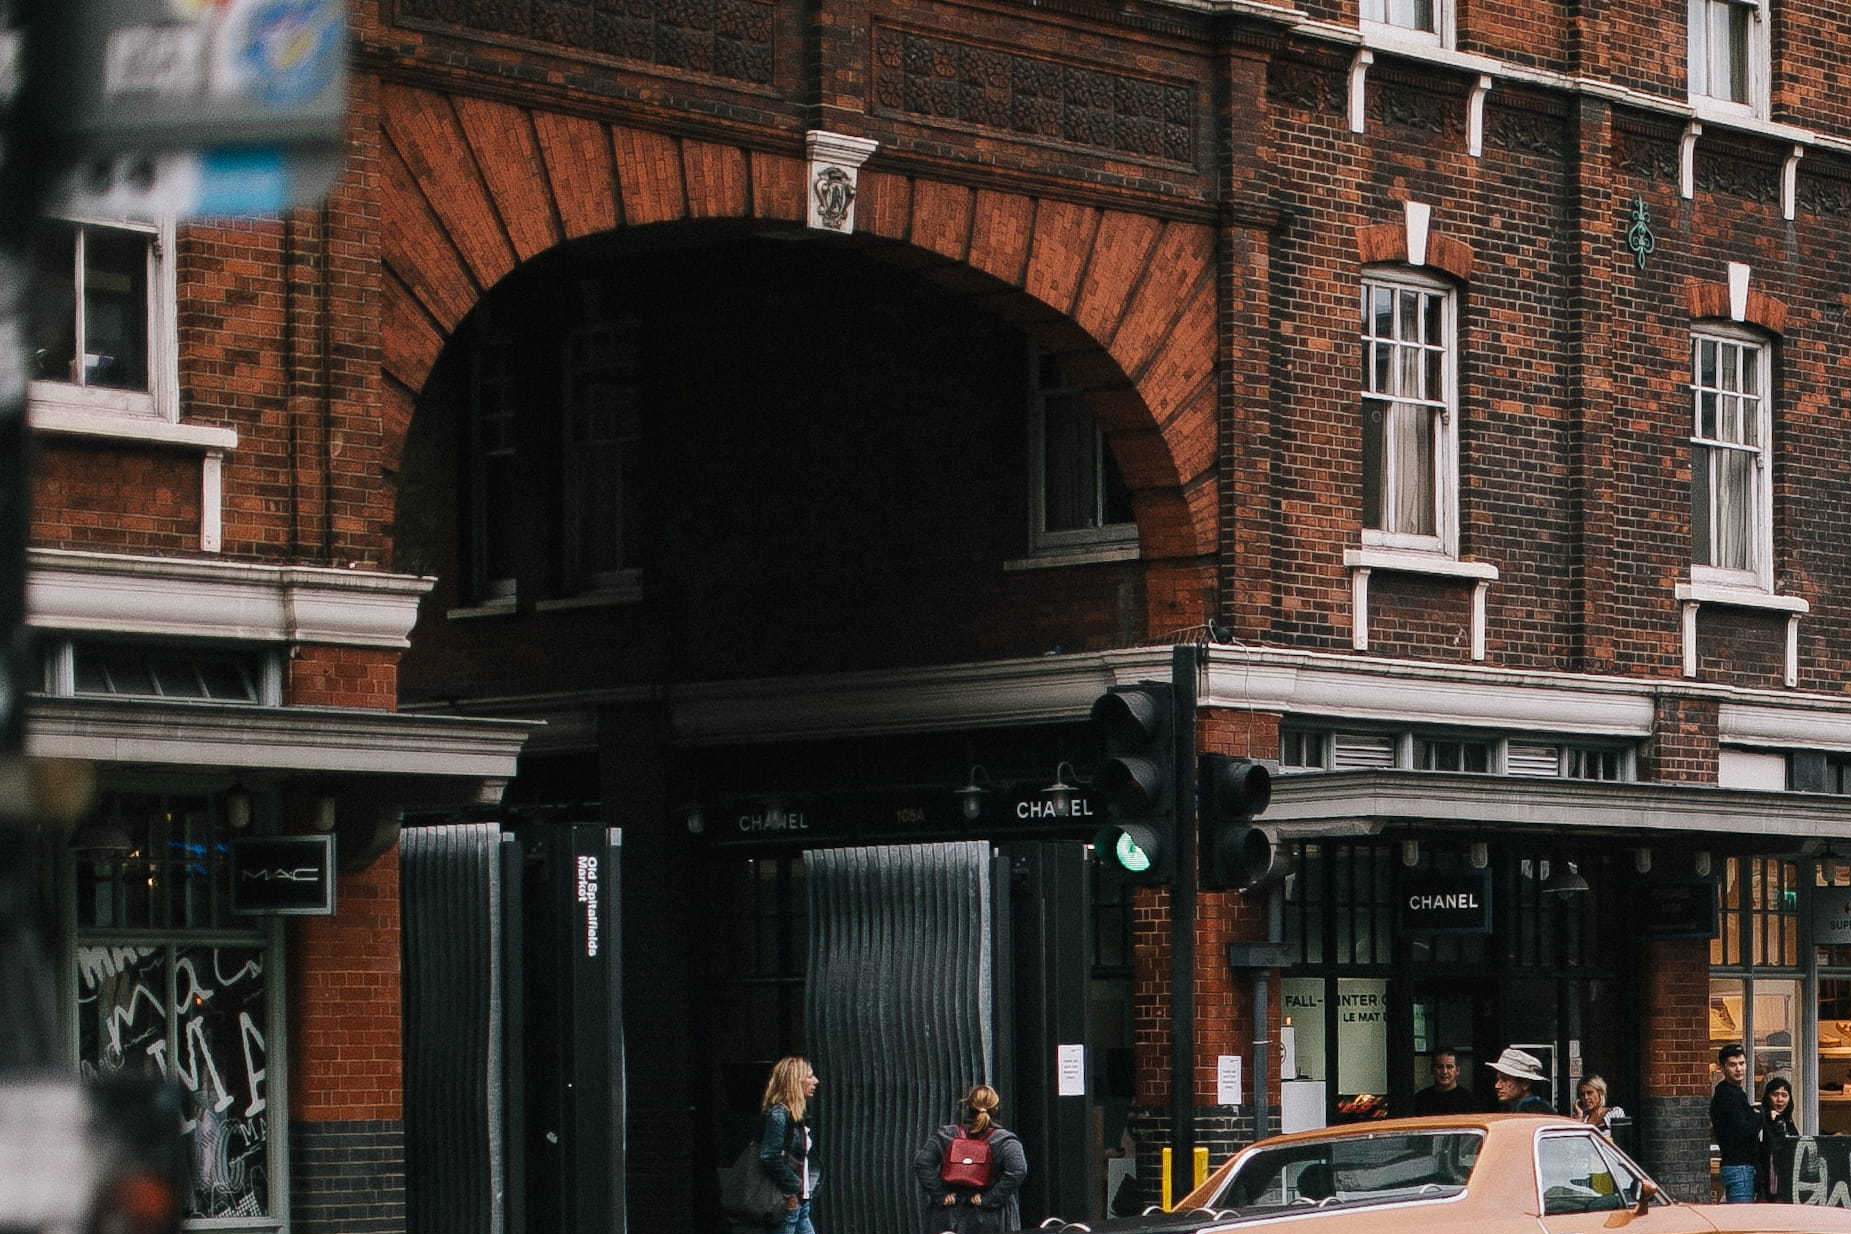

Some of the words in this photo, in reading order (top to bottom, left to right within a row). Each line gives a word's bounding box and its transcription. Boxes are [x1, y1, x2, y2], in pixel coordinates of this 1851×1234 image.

[1016, 799, 1093, 819] CHAEL
[577, 855, 589, 903] Market
[587, 856, 598, 880] Old
[1409, 893, 1479, 910] CHANEL
[586, 882, 599, 957] Spitalfields
[1343, 1012, 1355, 1022] LE
[1358, 1012, 1380, 1022] MAT
